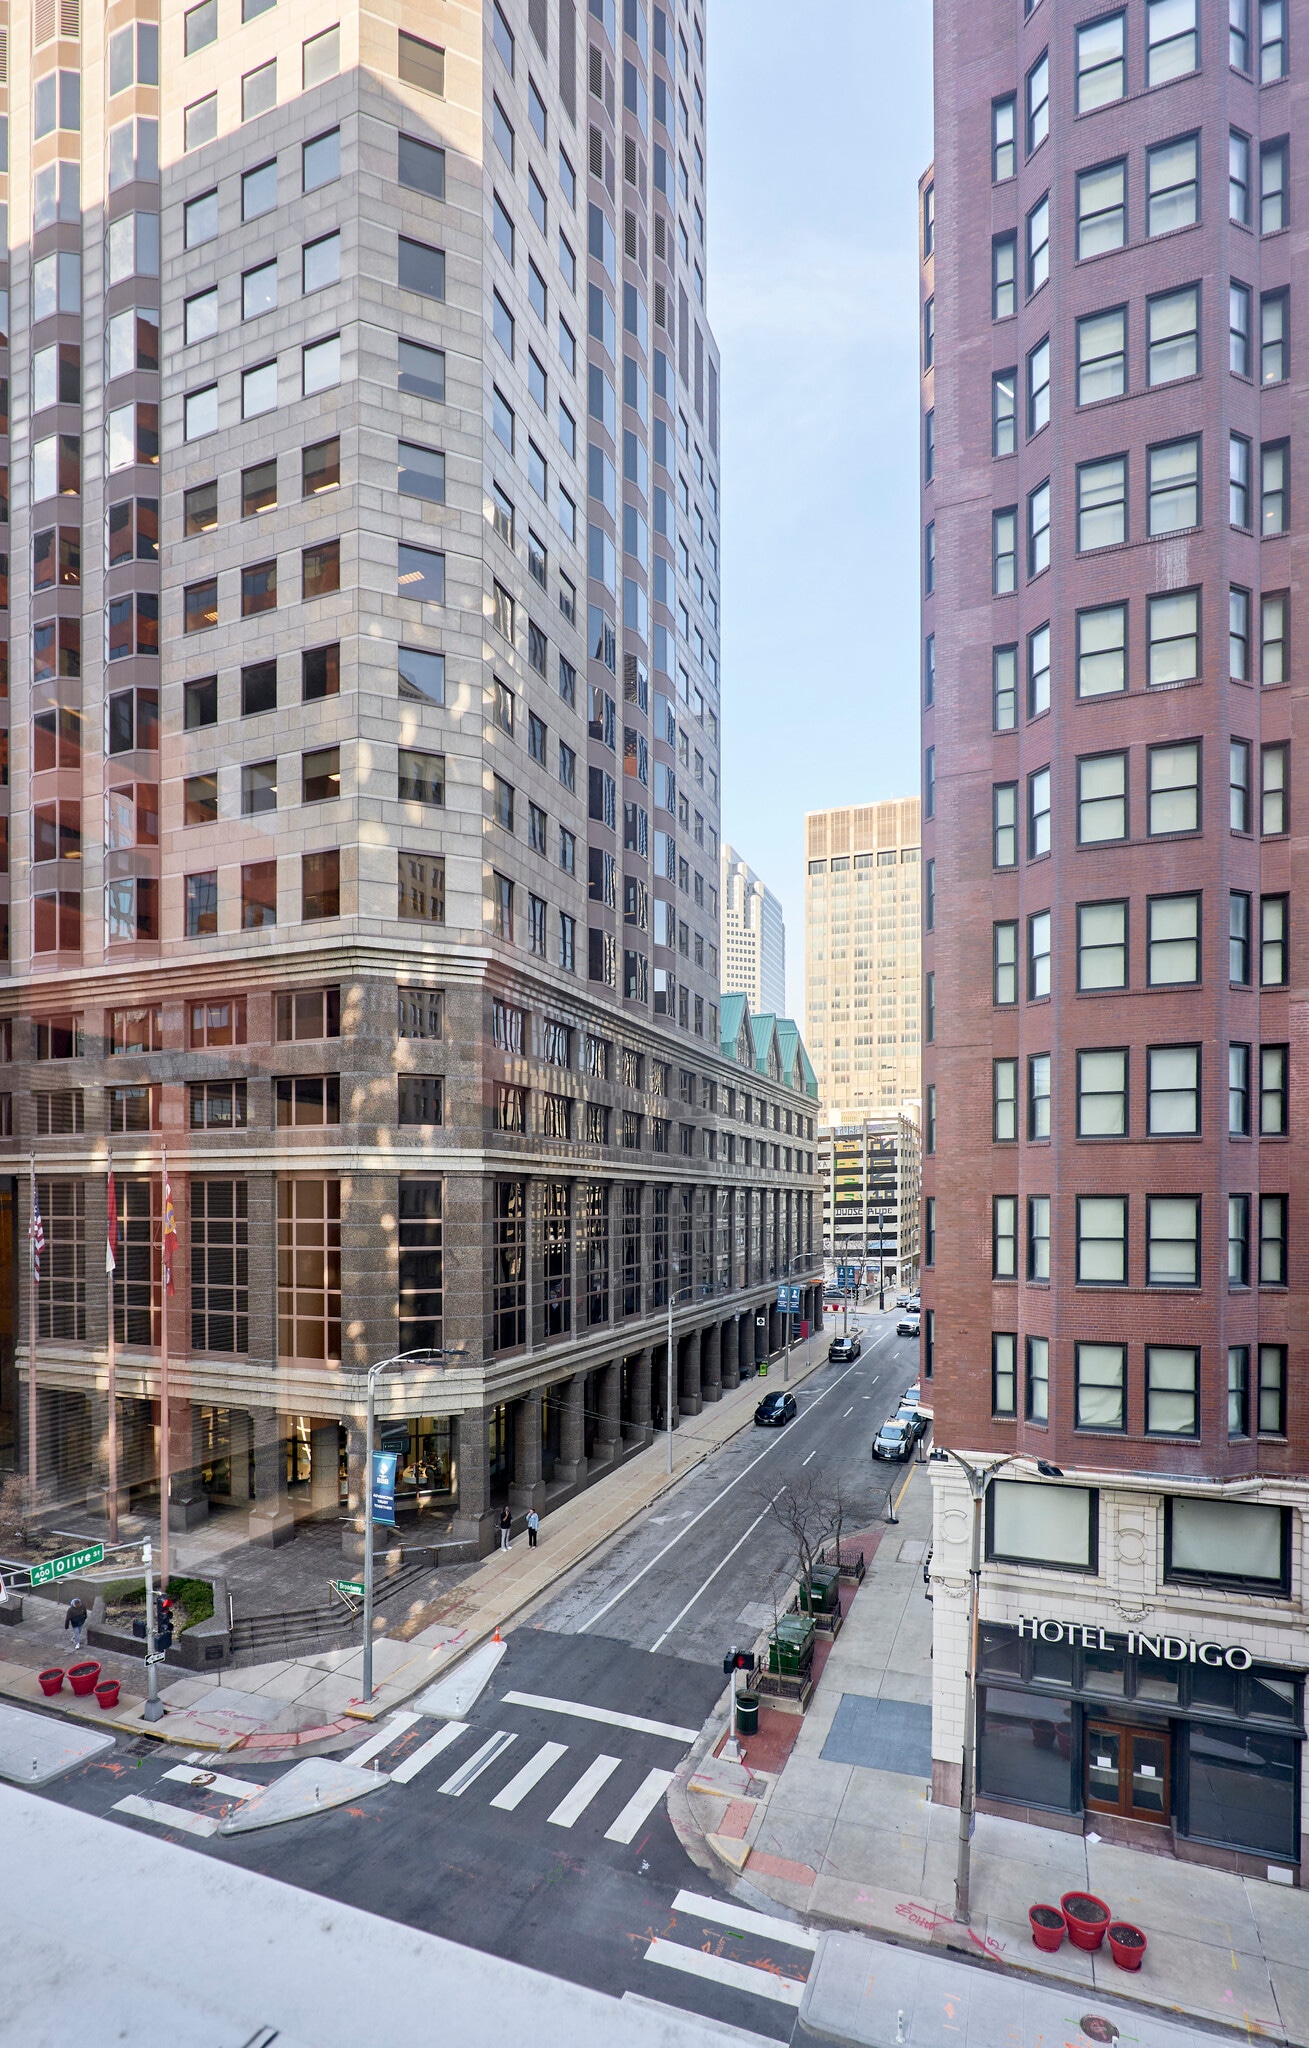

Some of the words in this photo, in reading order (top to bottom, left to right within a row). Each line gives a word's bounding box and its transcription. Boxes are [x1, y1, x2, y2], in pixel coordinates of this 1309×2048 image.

[56, 1553, 91, 1572] Olive
[93, 1549, 100, 1558] St
[34, 1568, 50, 1579] 400
[339, 1582, 362, 1594] Broadway
[1018, 1615, 1115, 1651] HOTEL
[1128, 1631, 1252, 1670] INDIGO
